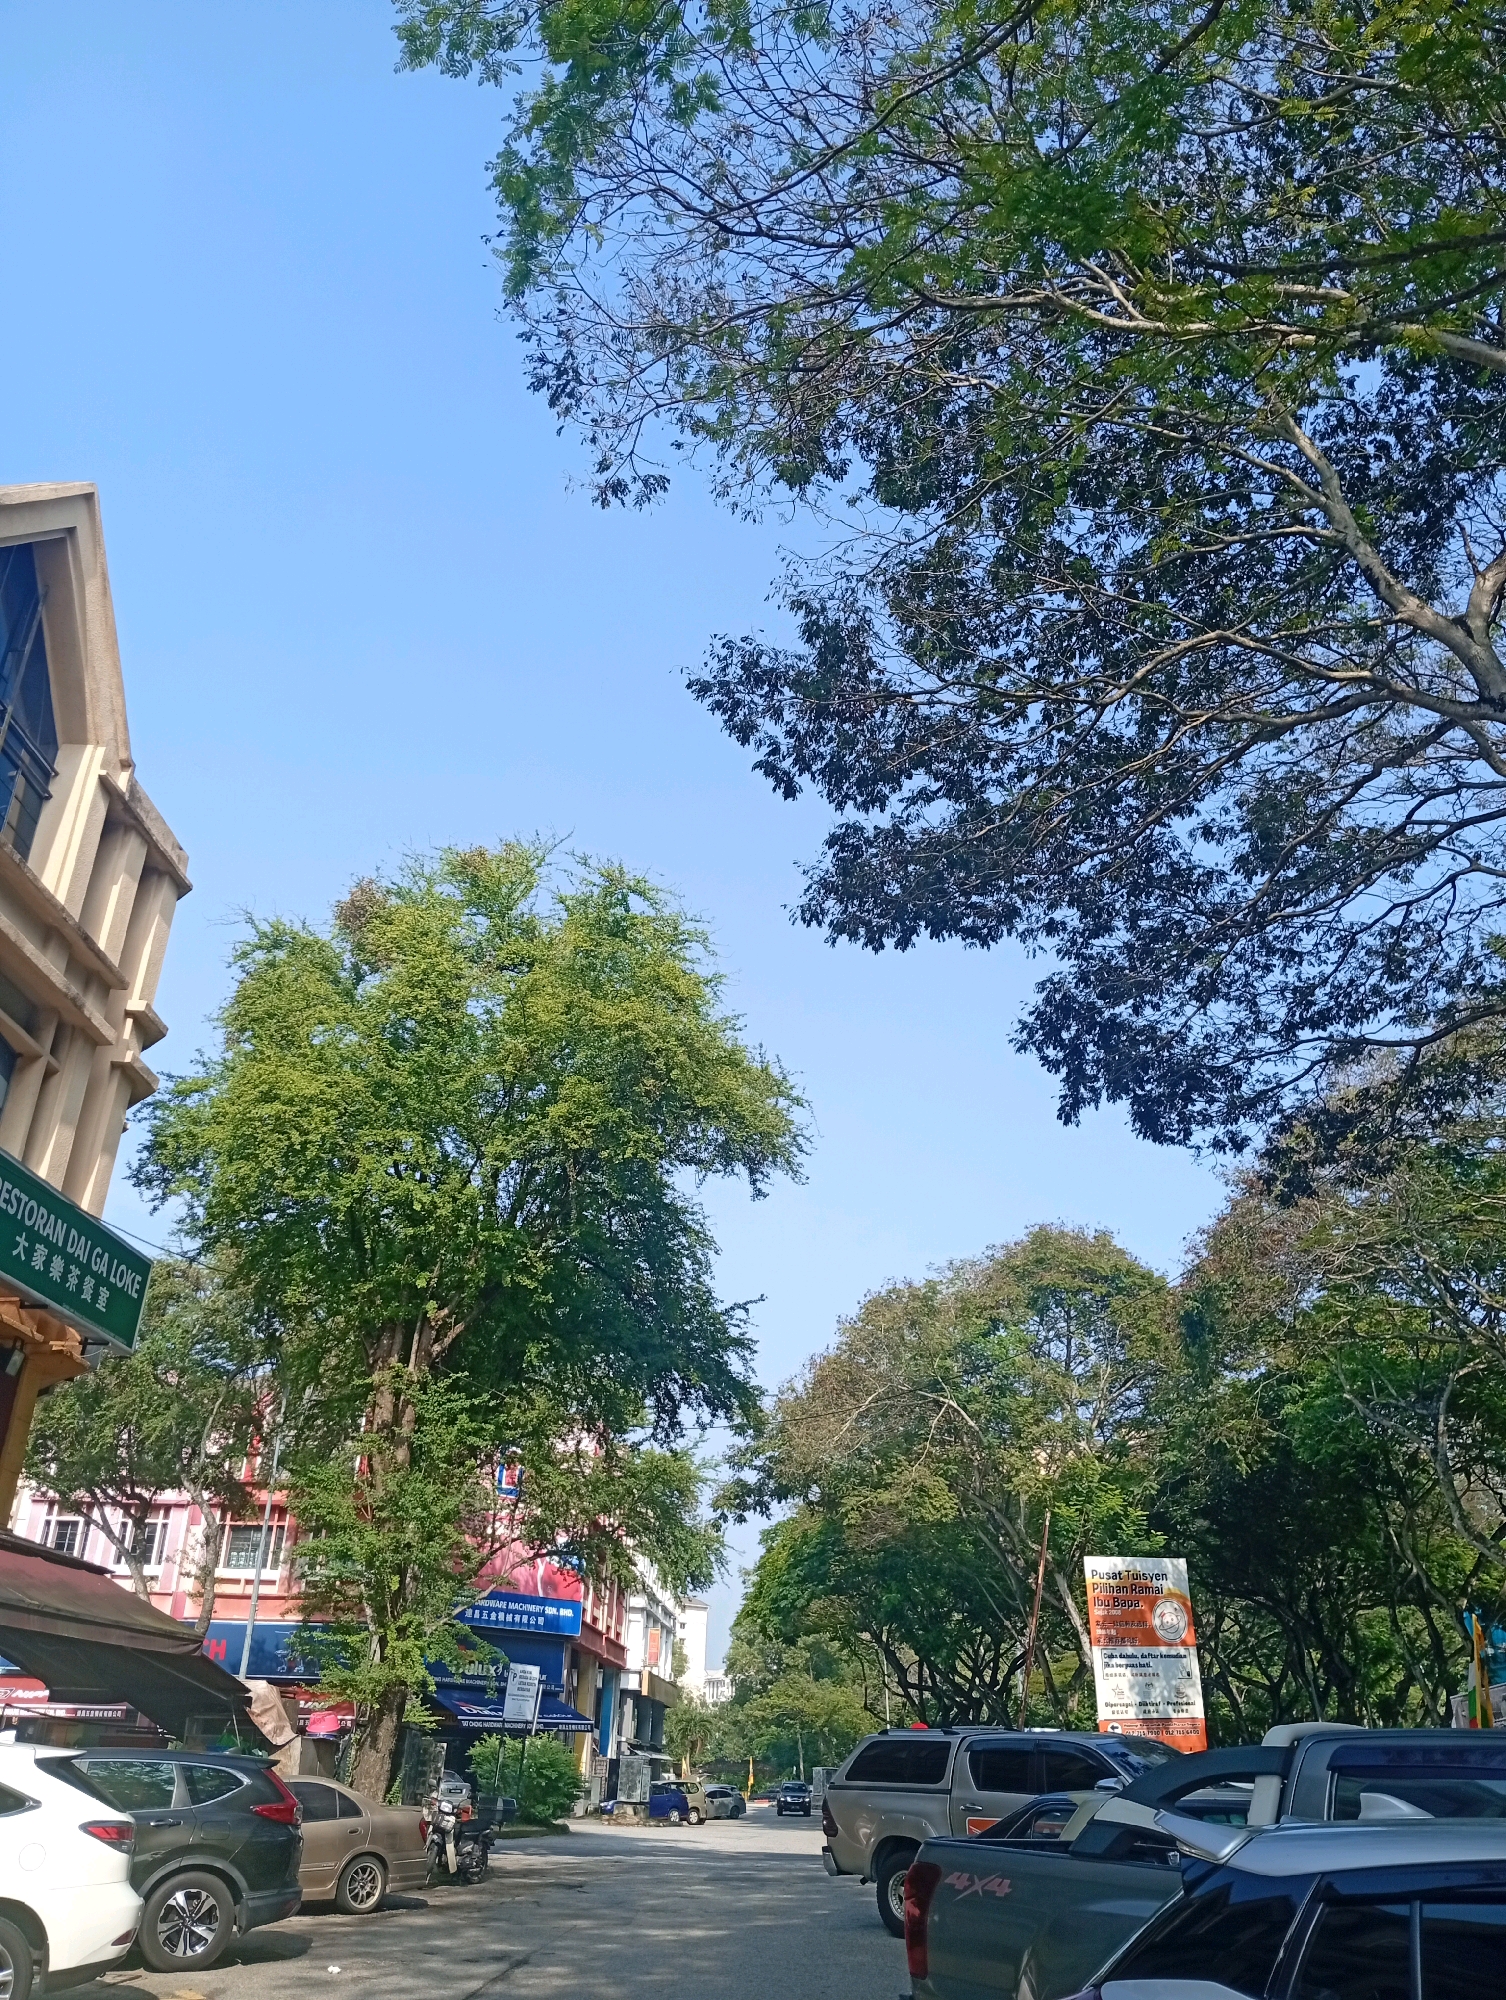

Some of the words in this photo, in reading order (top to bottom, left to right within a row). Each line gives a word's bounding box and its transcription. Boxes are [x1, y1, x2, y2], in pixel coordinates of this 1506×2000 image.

[0, 1176, 67, 1247] ESTORAN
[66, 1228, 91, 1264] DAI
[91, 1247, 109, 1278] GA
[109, 1259, 142, 1299] LOKE
[12, 1232, 110, 1313] 大家樂茶餐室
[1091, 1569, 1123, 1580] Pusat
[1125, 1570, 1168, 1582] Tuisyen
[1092, 1583, 1129, 1595] Pilihan
[1131, 1584, 1164, 1595] Ramai
[508, 1602, 544, 1613] MACHINERY
[544, 1606, 559, 1615] SDN.
[560, 1608, 574, 1617] BHD.
[1093, 1597, 1110, 1608] Ibu
[1113, 1597, 1144, 1611] Bapa.
